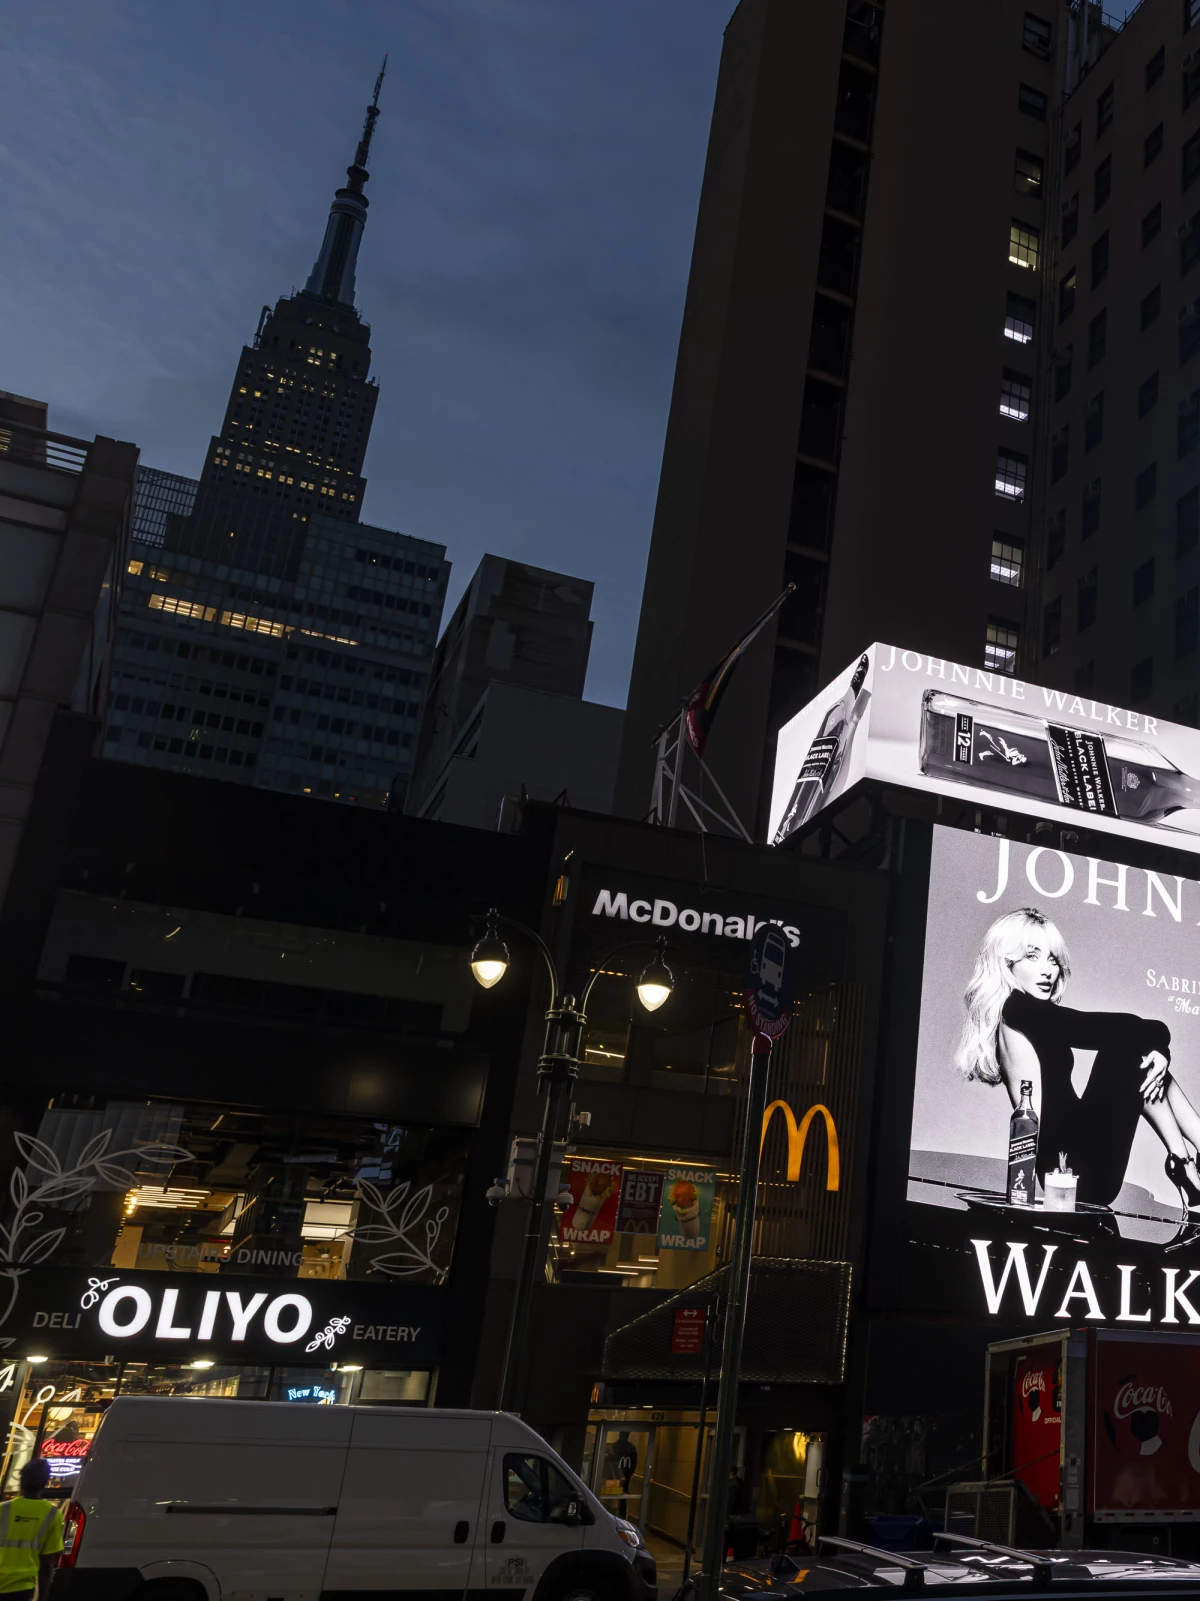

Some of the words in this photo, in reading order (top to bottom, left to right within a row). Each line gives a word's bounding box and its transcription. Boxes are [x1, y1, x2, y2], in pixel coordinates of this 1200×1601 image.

[881, 646, 1026, 701] JOHNNIE
[1041, 686, 1159, 736] WALKER
[957, 732, 971, 747] 12
[1075, 732, 1089, 771] BLACK
[1085, 740, 1099, 776] JOHNNIE
[755, 1013, 788, 1036] STANDING
[572, 1160, 621, 1176] SNACK
[668, 1169, 714, 1184] SNACK
[638, 1174, 659, 1183] ACCEPT
[624, 1181, 659, 1202] EBT
[563, 1227, 611, 1243] WRAP
[661, 1234, 706, 1249] WRAP
[139, 1243, 231, 1263] UPSTAIRS
[237, 1249, 304, 1267] DINING
[32, 1311, 81, 1329] DELI
[98, 1285, 313, 1344] OLIYO
[352, 1325, 421, 1342] EATERY
[288, 1388, 310, 1400] New
[651, 1411, 665, 1421] 429
